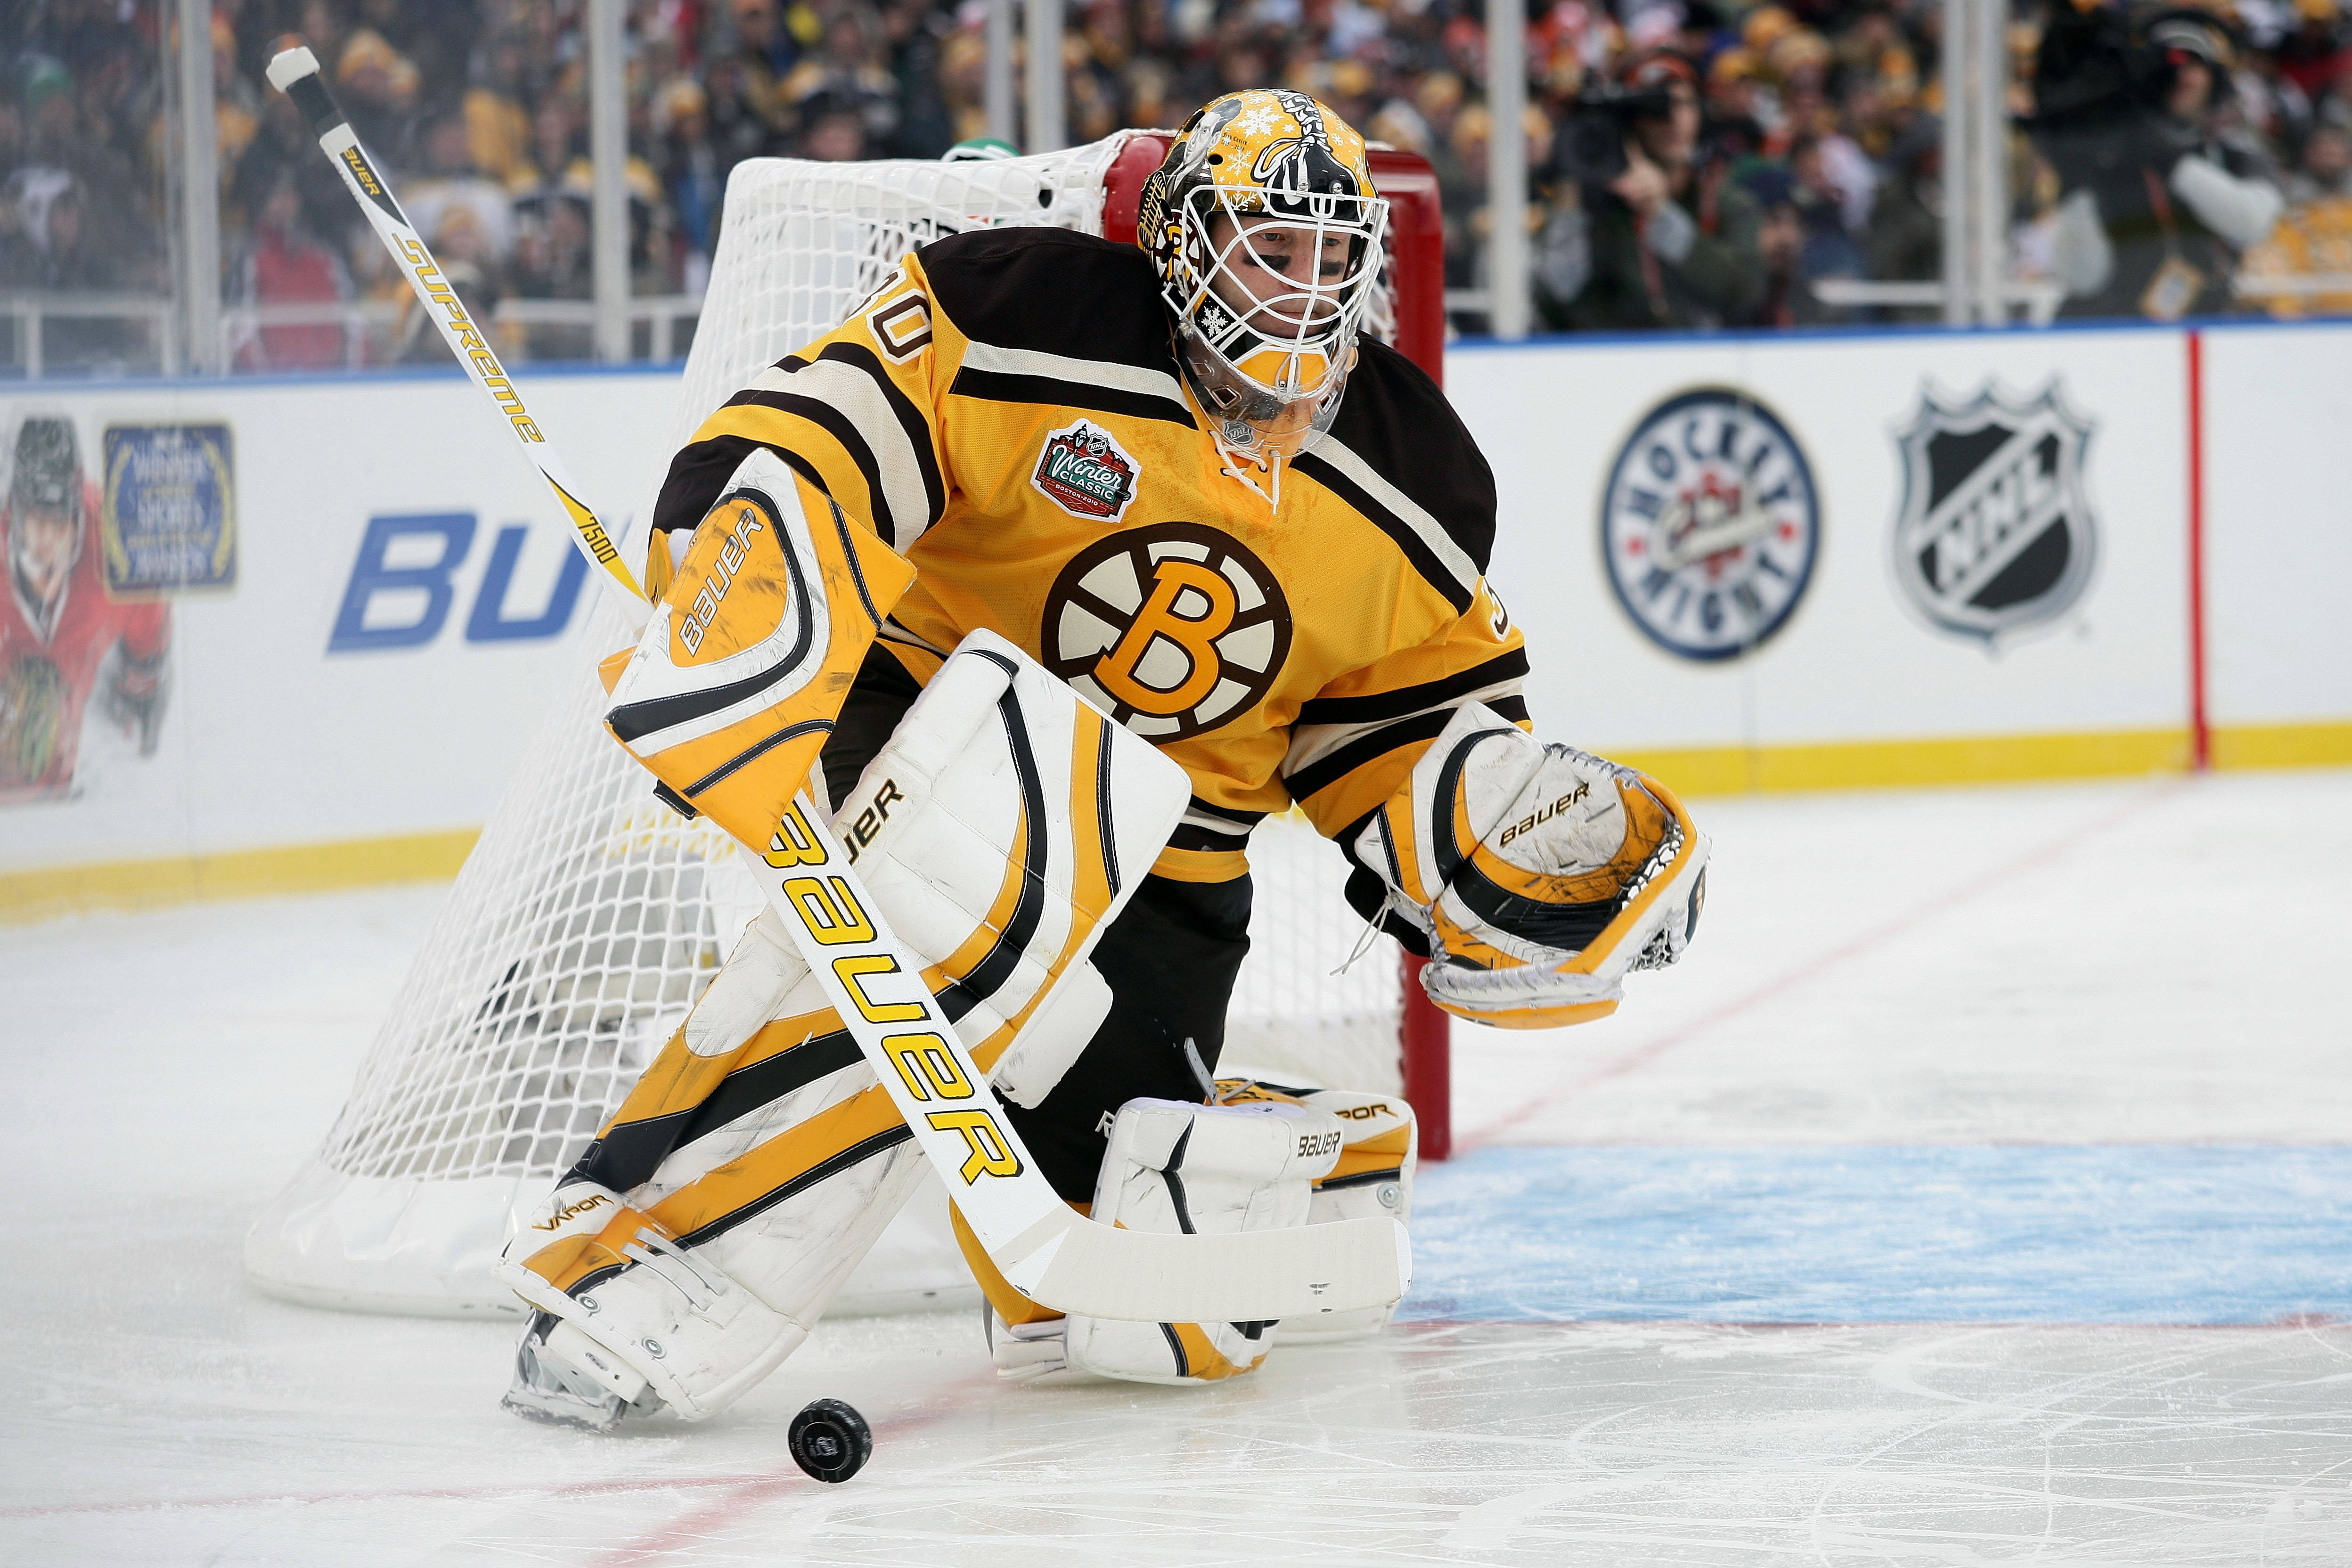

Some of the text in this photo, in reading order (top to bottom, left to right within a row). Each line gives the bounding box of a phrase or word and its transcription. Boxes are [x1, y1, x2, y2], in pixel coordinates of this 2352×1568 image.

[391, 232, 546, 443] SUPREME
[1090, 442, 1106, 450] NHL
[1229, 426, 1248, 439] NHL
[1052, 444, 1121, 490] Winter
[1060, 470, 1115, 500] CLASSIC
[578, 515, 619, 564] 7500
[1933, 438, 2058, 596] NHL
[679, 507, 764, 657] BAUER
[1094, 561, 1235, 714] B
[1499, 781, 1591, 849] BAUER
[762, 799, 1024, 1186] BAUER
[1297, 1131, 1341, 1159] BAUER
[531, 1194, 616, 1232] VAPOR
